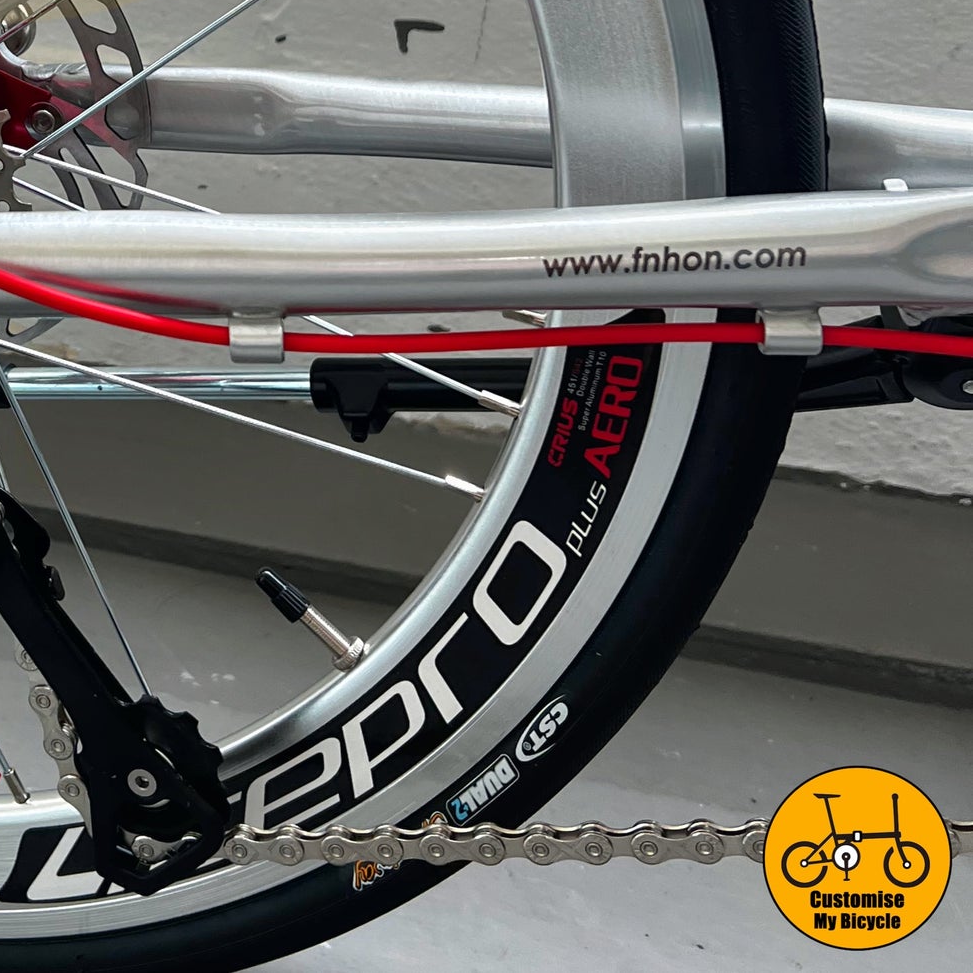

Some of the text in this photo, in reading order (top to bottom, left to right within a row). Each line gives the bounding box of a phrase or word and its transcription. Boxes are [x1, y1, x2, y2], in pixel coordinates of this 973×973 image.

[542, 246, 807, 278] www.fnhon.com
[577, 349, 596, 397] Double Wall
[547, 397, 578, 468] CRIUS
[578, 408, 592, 432] Super
[583, 355, 644, 479] AERO
